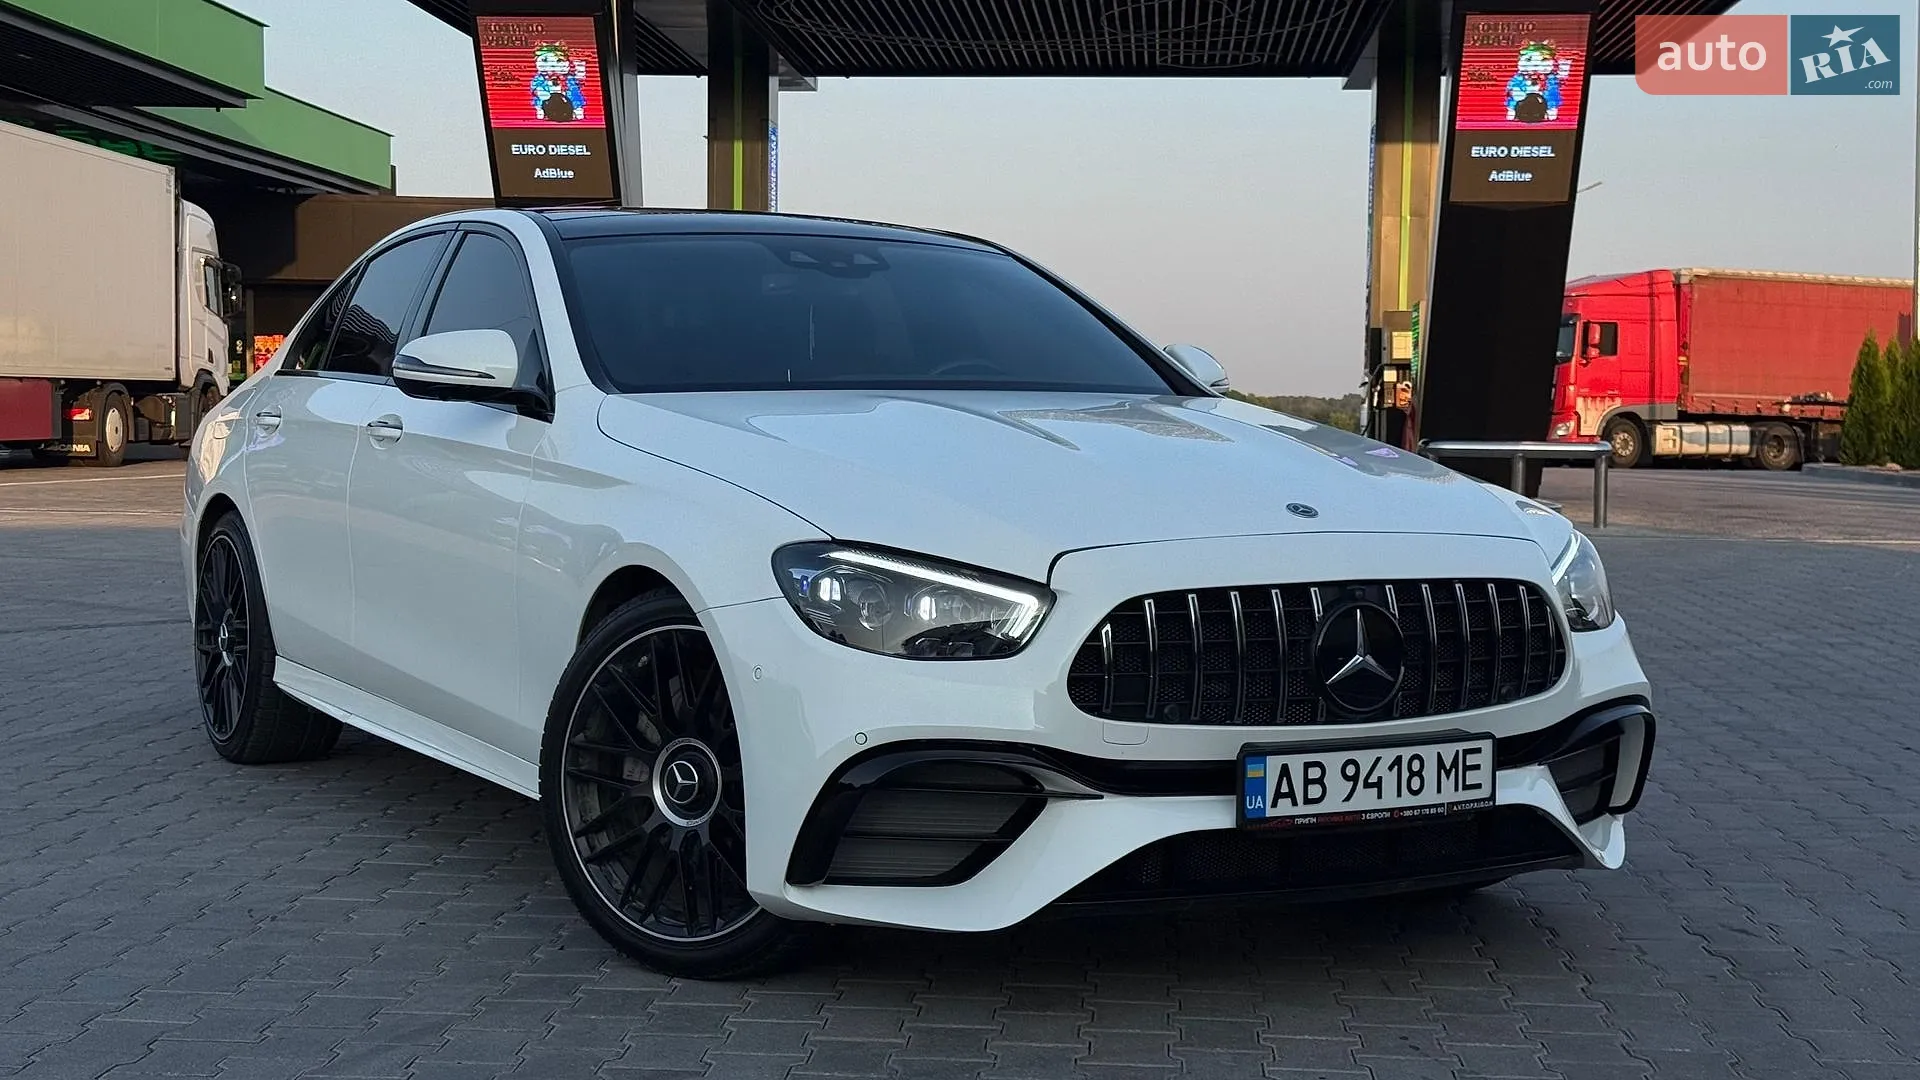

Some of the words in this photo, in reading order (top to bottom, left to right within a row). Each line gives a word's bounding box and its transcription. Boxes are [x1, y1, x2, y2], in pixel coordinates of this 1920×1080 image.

[511, 144, 546, 155] EURO
[548, 144, 591, 156] DIESEL
[1471, 146, 1508, 157] EURO
[1510, 146, 1555, 157] DIESEL
[534, 168, 574, 179] AdBlue
[1488, 170, 1532, 182] AdBlue
[1270, 761, 1327, 808] AB
[1340, 753, 1425, 803] 9418
[1436, 746, 1482, 794] ME
[1246, 795, 1264, 809] UA
